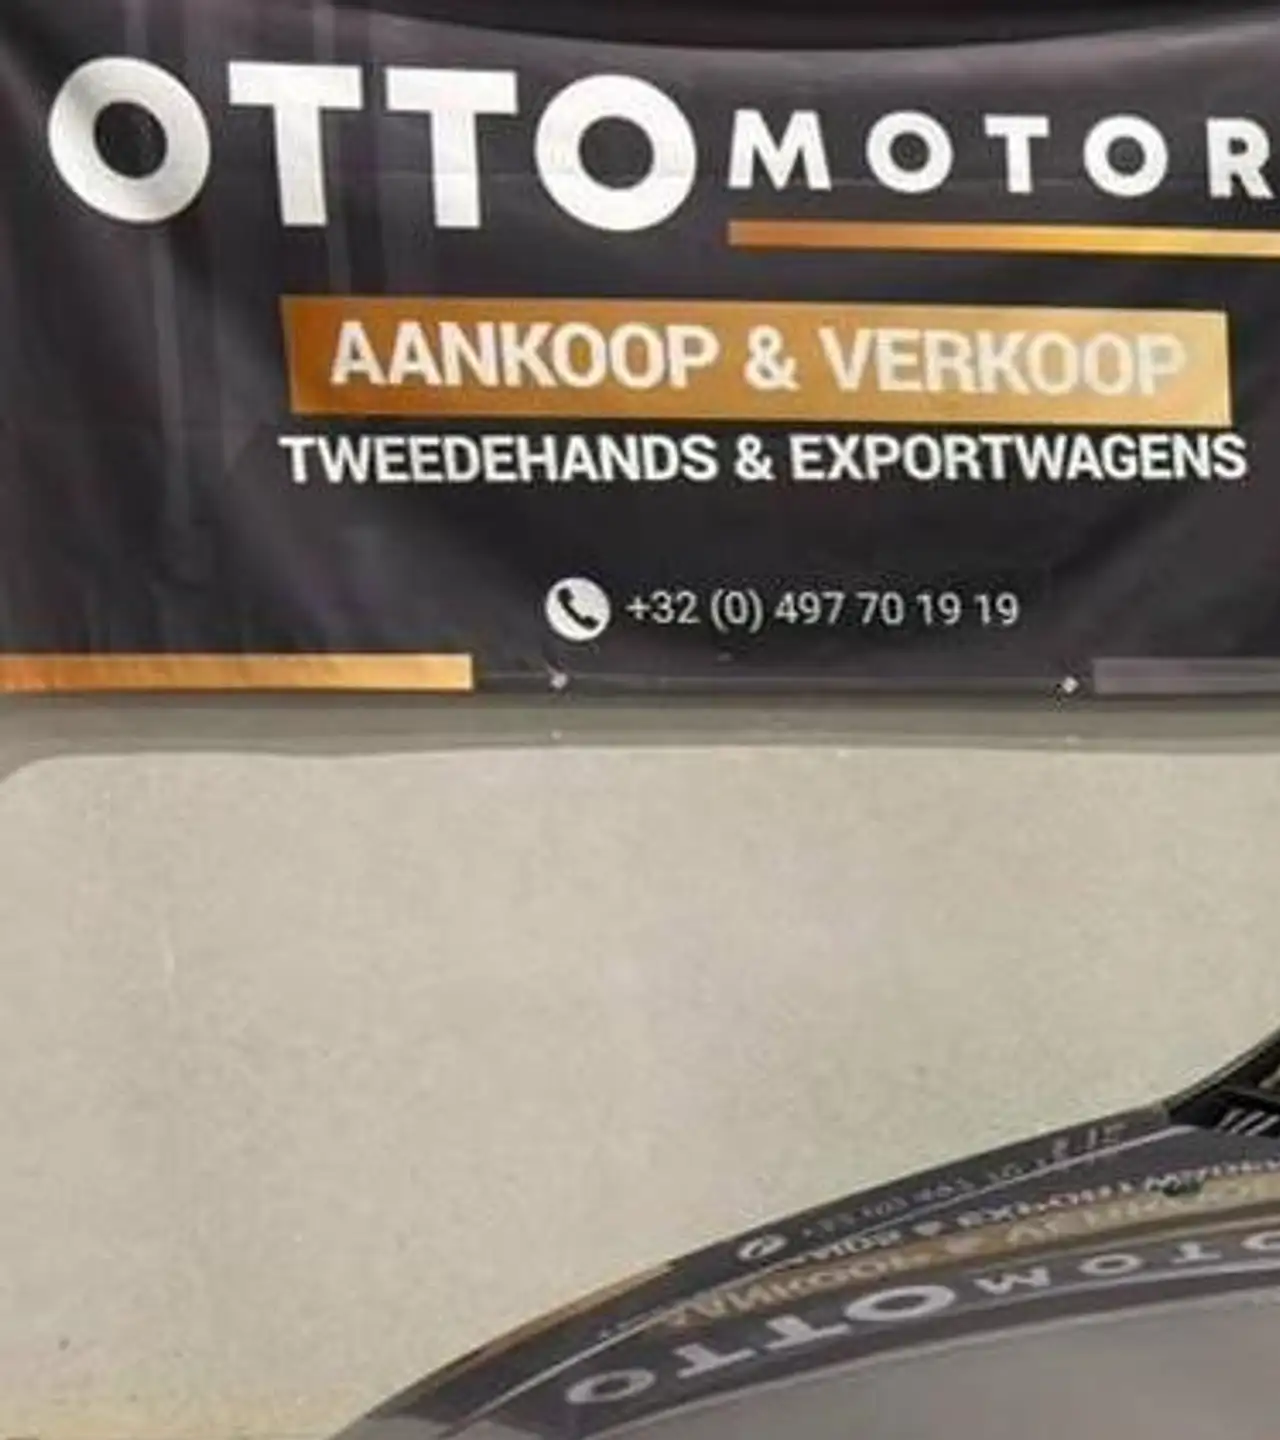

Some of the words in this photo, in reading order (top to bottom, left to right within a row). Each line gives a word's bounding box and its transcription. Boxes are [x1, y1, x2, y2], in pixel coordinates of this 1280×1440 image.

[47, 56, 698, 232] OTTO
[330, 320, 721, 390] AANKOOP
[744, 324, 800, 392] &
[818, 326, 1189, 396] VERKOOP
[277, 434, 720, 484] TWEEDEHANDS
[733, 434, 775, 482] &
[789, 434, 1248, 482] EXPORTWAGENS
[625, 590, 700, 625] +32
[711, 589, 764, 633] (0)
[774, 591, 845, 625] 497
[857, 591, 904, 626] 70
[917, 592, 961, 626] 19
[976, 592, 1020, 627] 19
